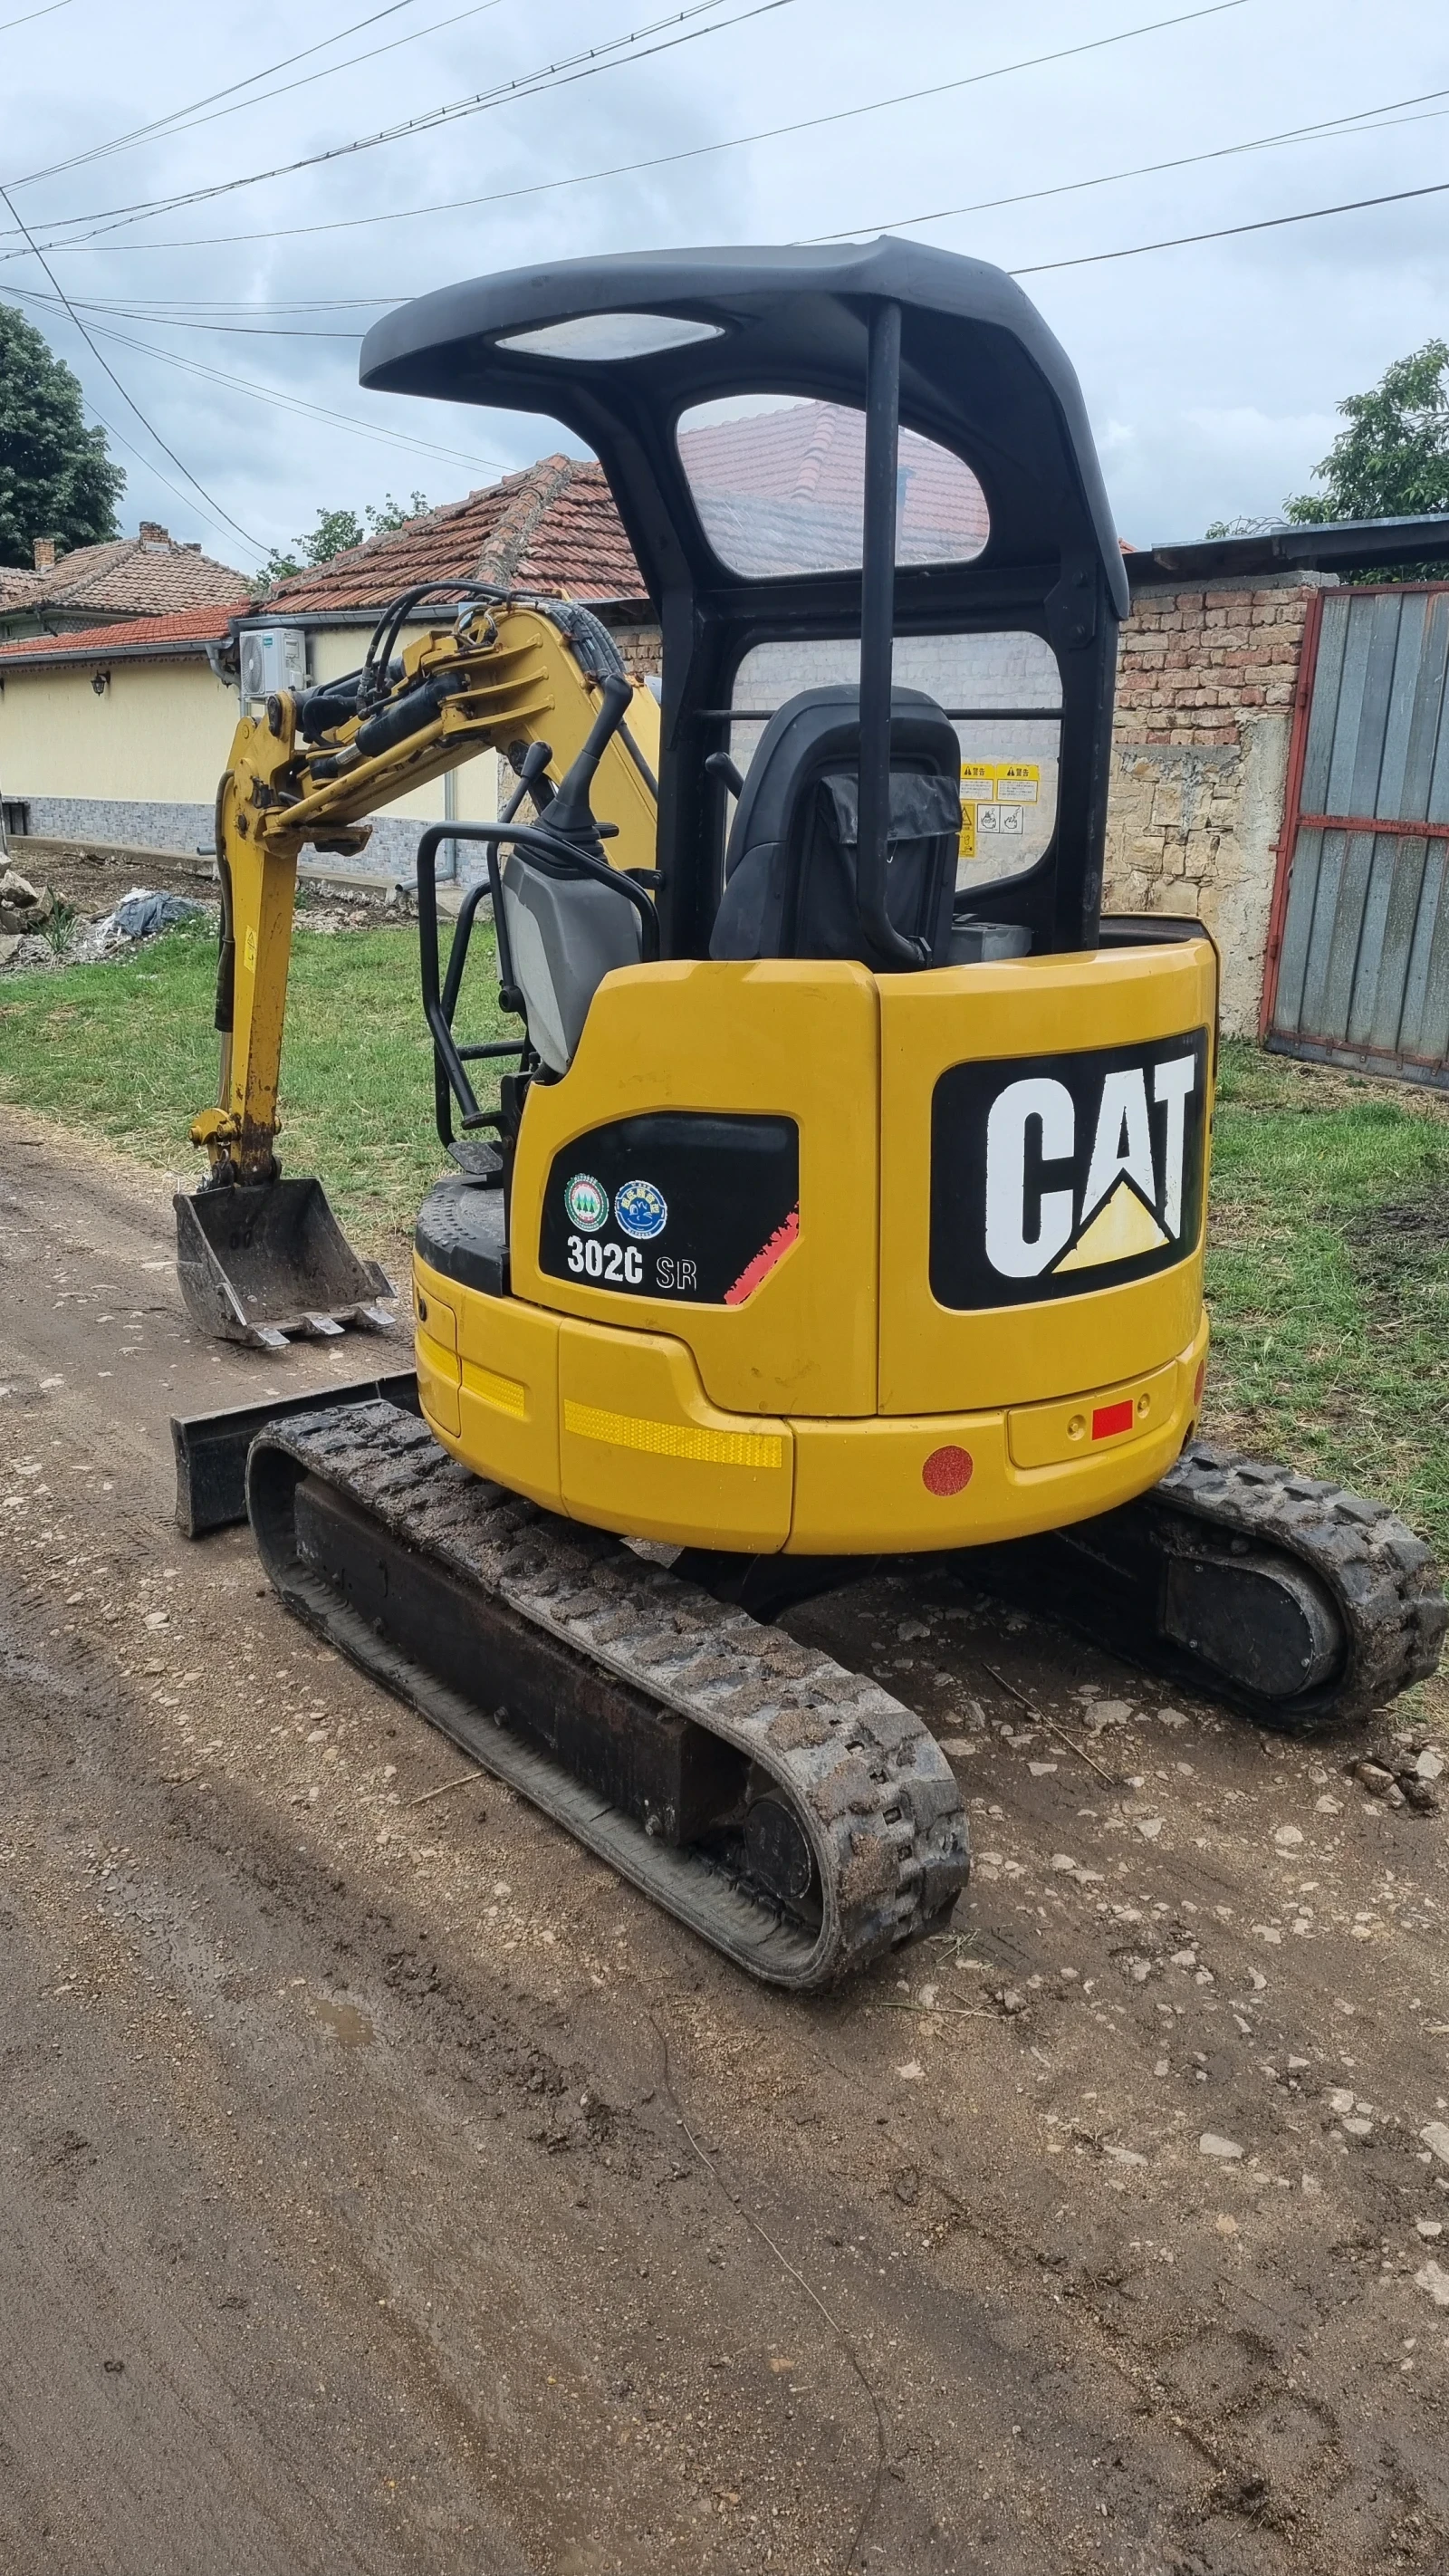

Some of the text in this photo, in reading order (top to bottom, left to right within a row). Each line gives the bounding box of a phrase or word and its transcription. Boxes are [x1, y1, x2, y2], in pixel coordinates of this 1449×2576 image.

[985, 1054, 1195, 1278] CAT
[567, 1235, 697, 1291] 302C SR
